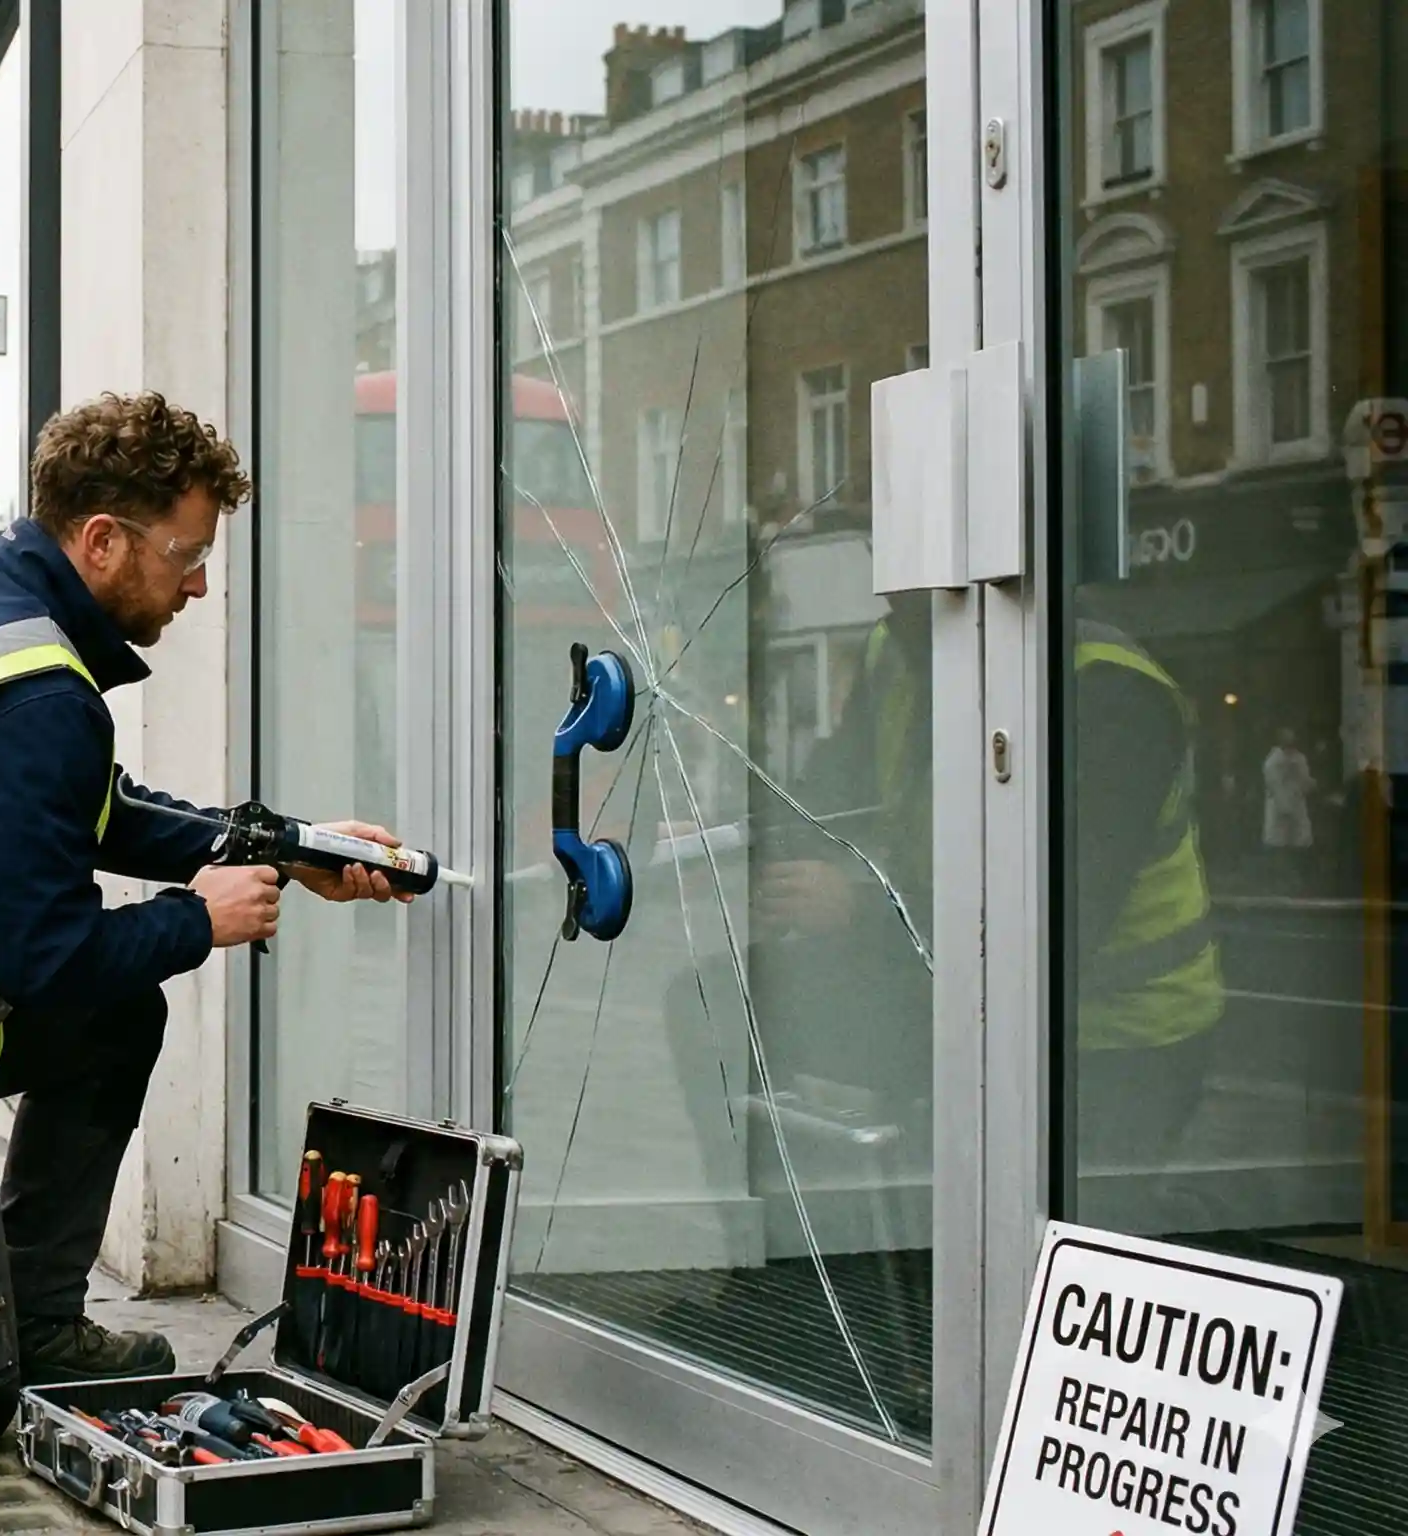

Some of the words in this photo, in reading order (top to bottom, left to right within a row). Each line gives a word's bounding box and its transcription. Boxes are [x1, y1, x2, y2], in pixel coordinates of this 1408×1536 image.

[1052, 1283, 1292, 1402] CAUTION:
[1054, 1376, 1191, 1459] REPAIR
[1200, 1416, 1247, 1475] IN
[1035, 1434, 1241, 1536] PROGRESS
